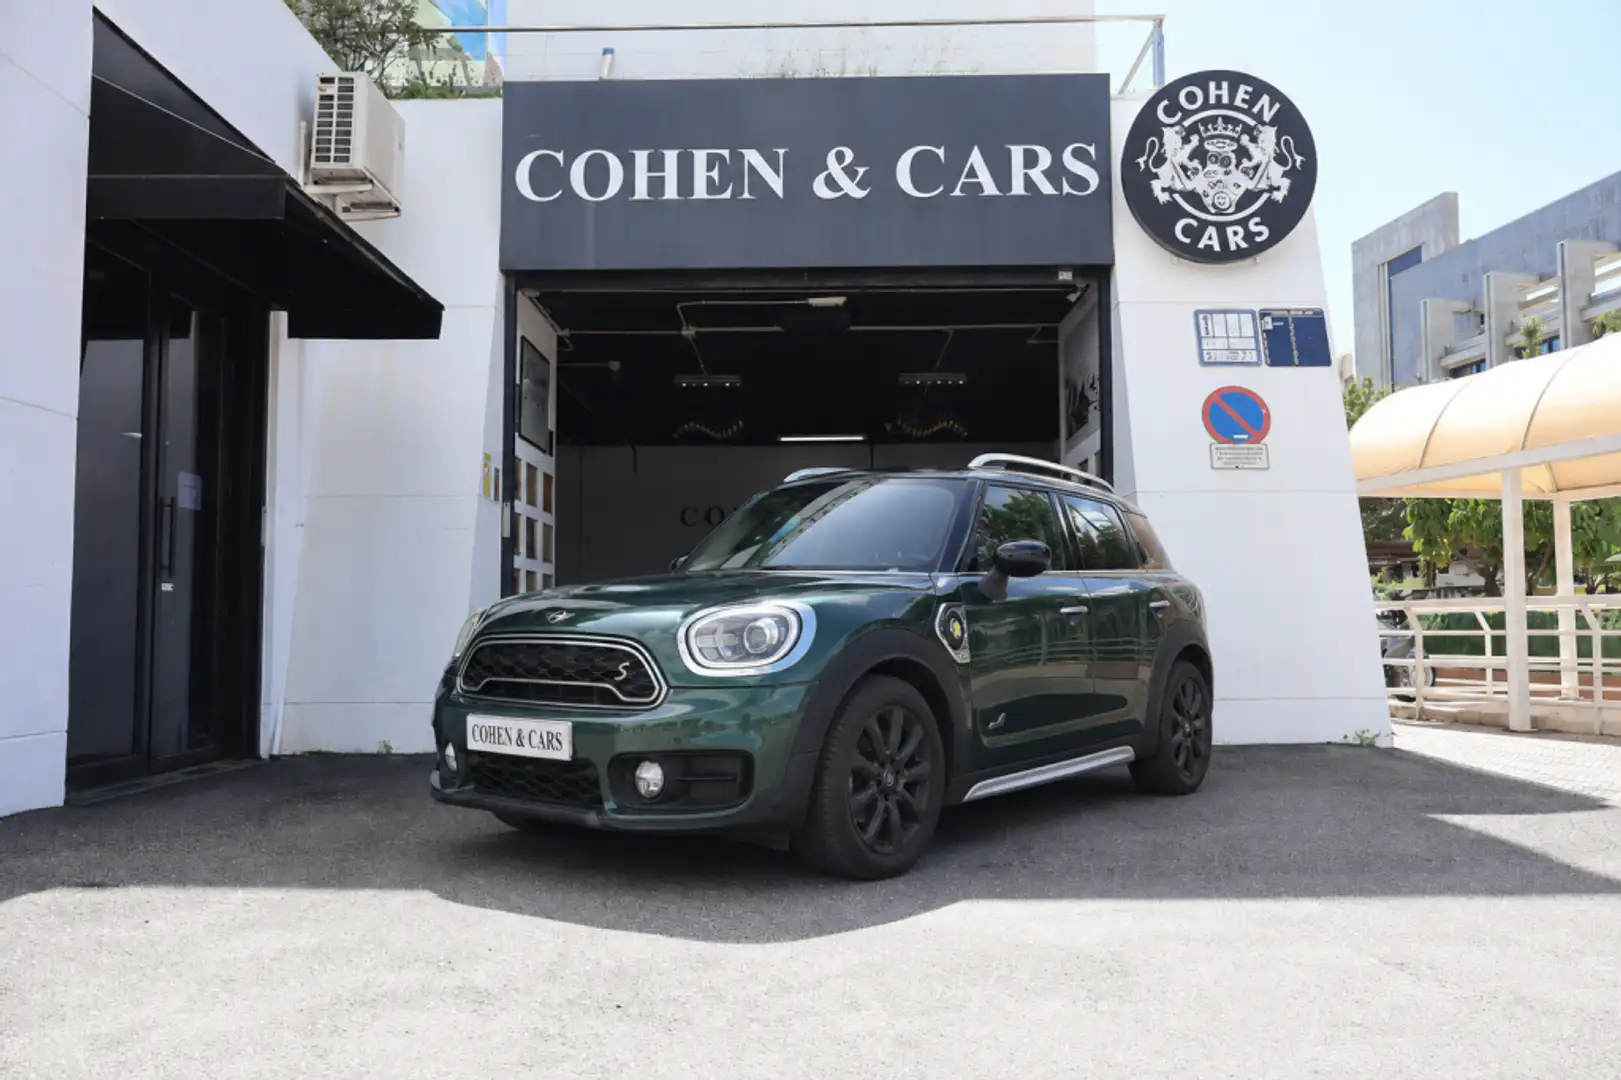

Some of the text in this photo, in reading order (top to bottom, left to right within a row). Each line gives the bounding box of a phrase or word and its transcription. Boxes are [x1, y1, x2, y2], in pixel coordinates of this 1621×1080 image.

[1157, 81, 1281, 126] COHEN
[514, 142, 1100, 202] COHEN & CARS
[1174, 216, 1270, 252] CARS
[614, 661, 630, 681] S
[471, 723, 564, 751] COHEN & CARS
